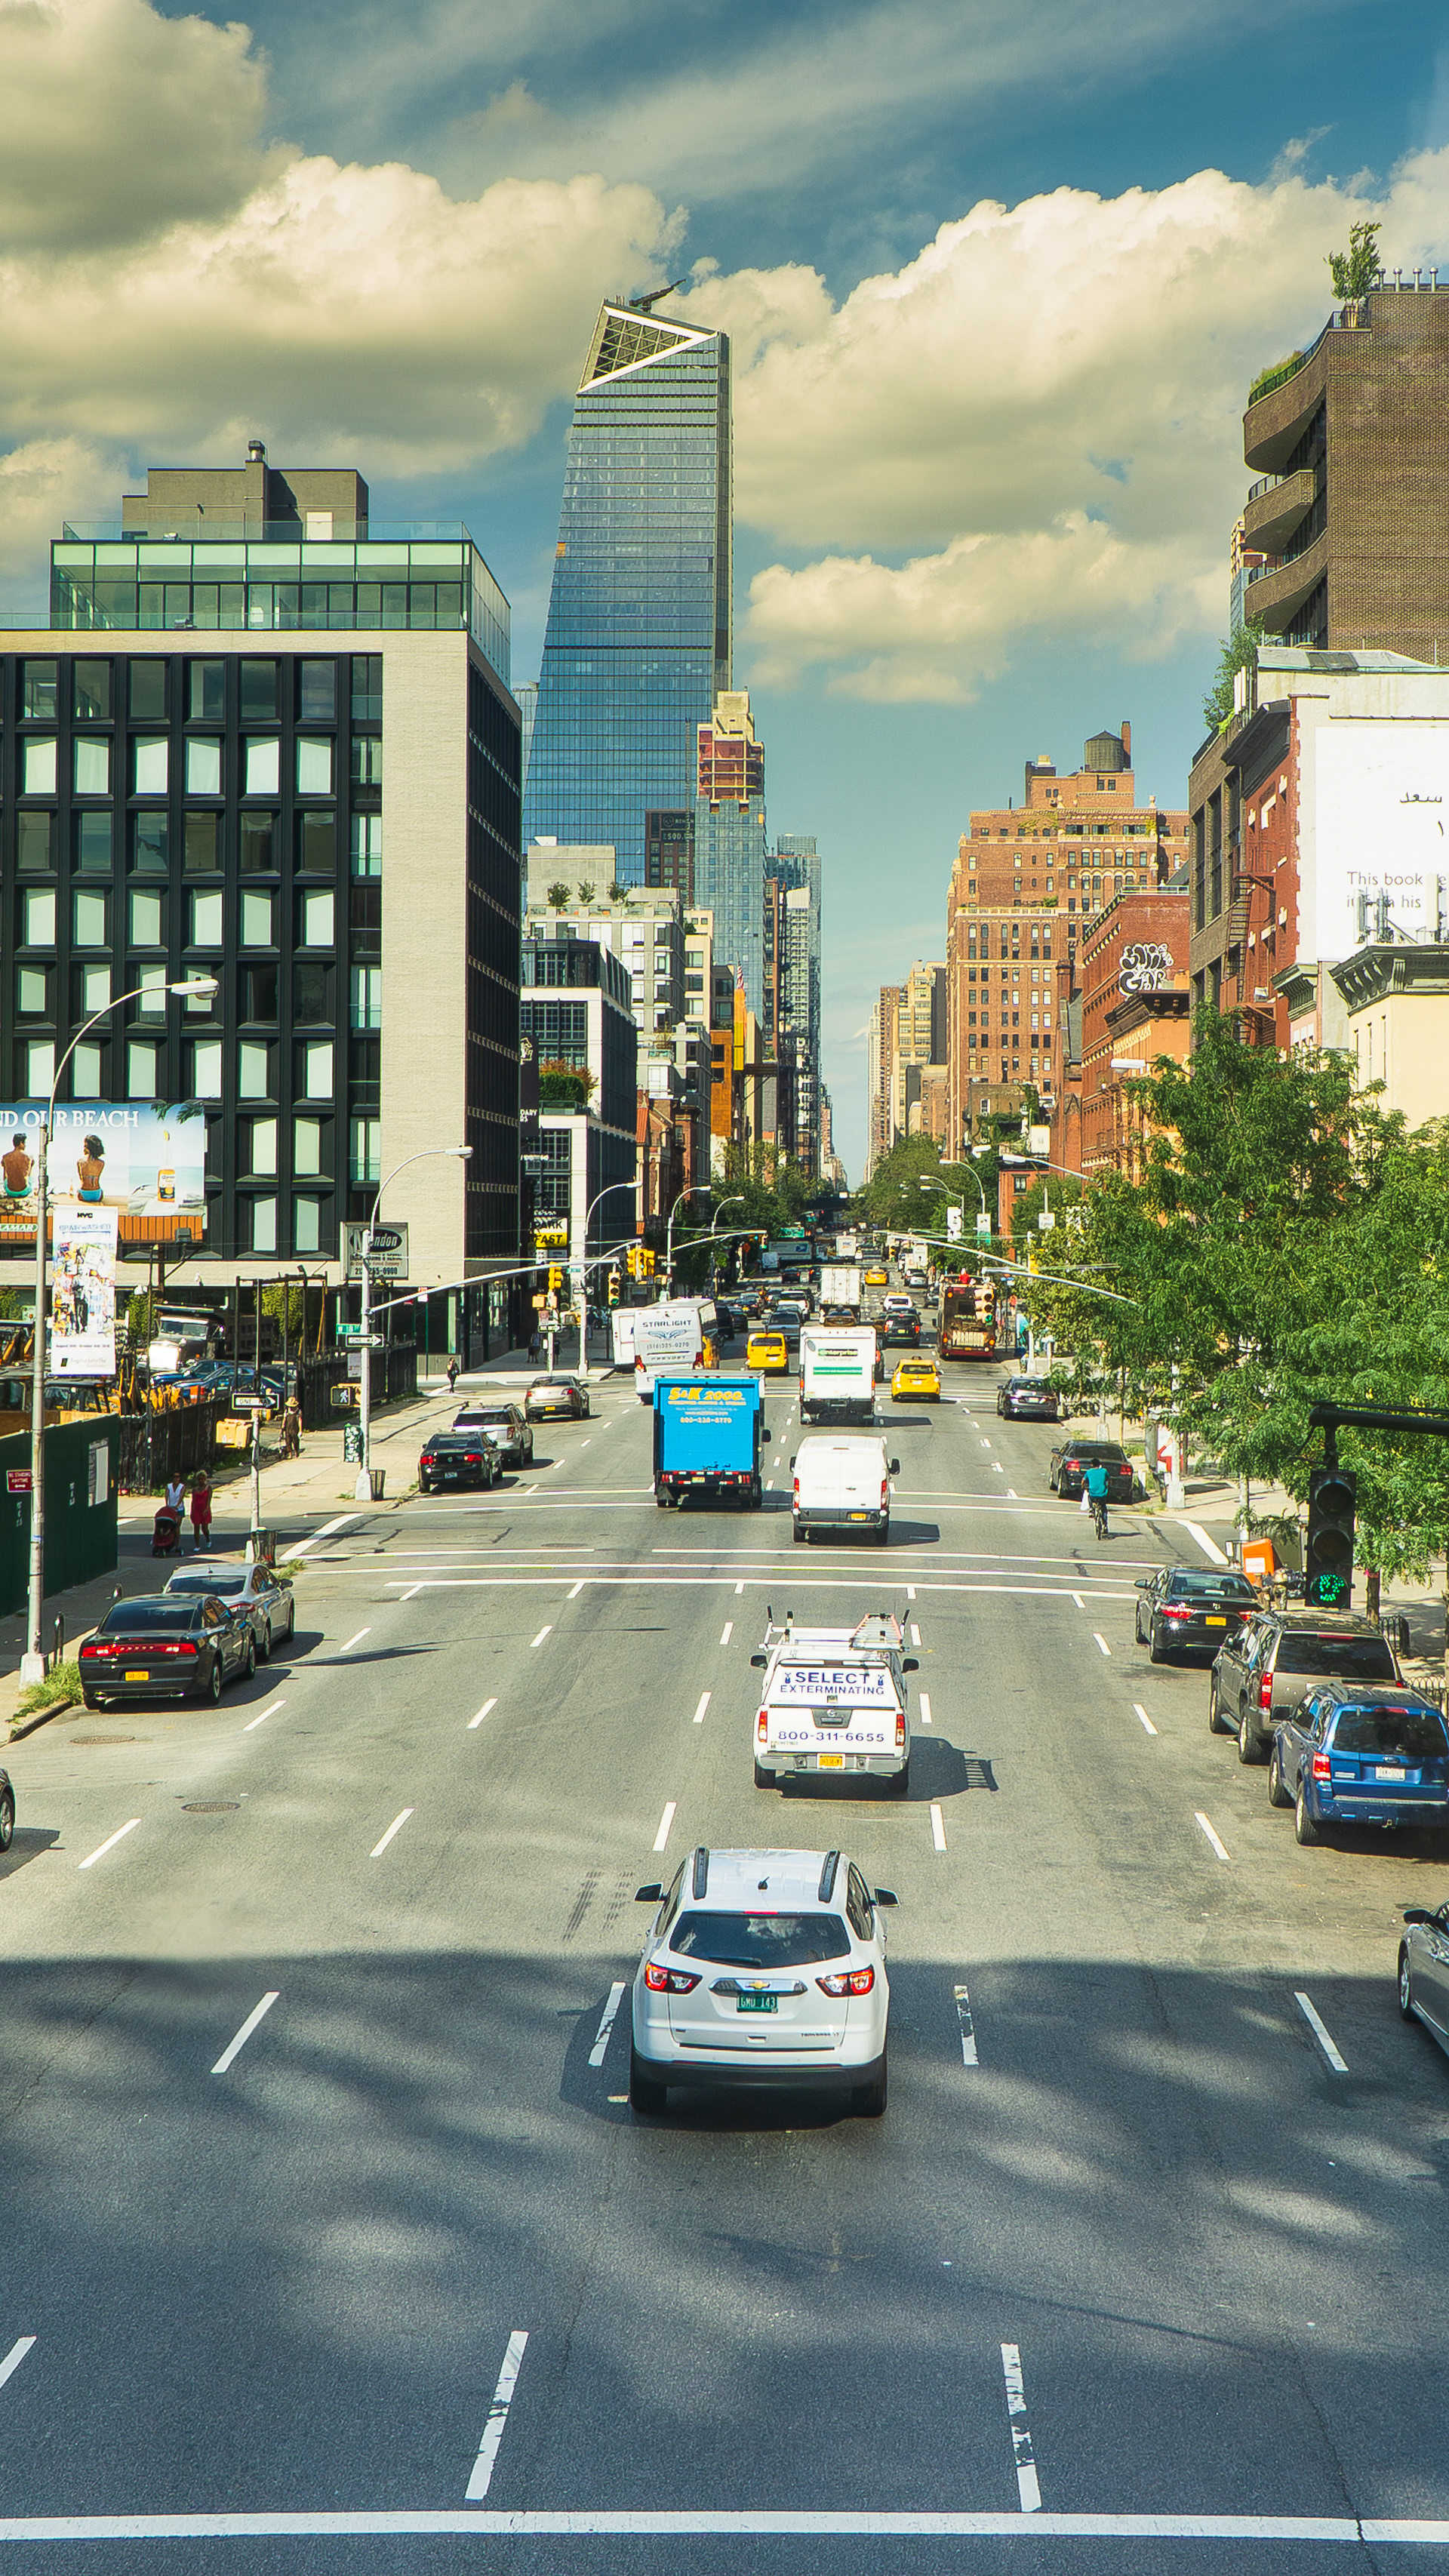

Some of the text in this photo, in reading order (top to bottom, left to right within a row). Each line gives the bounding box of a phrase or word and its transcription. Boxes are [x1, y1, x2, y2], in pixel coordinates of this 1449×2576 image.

[1346, 871, 1378, 885] This
[1384, 873, 1423, 885] book
[1401, 894, 1421, 908] his
[72, 1109, 139, 1128] BEACH
[0, 1223, 35, 1232] AMAR
[534, 1218, 563, 1230] PARK
[534, 1234, 563, 1244] FAST
[642, 1319, 691, 1328] STARLIGHT
[668, 1387, 743, 1401] S&K 2000
[795, 1672, 869, 1684] SELECT
[780, 1685, 884, 1695] EXTERMINATING
[778, 1731, 884, 1742] 800-311-6655
